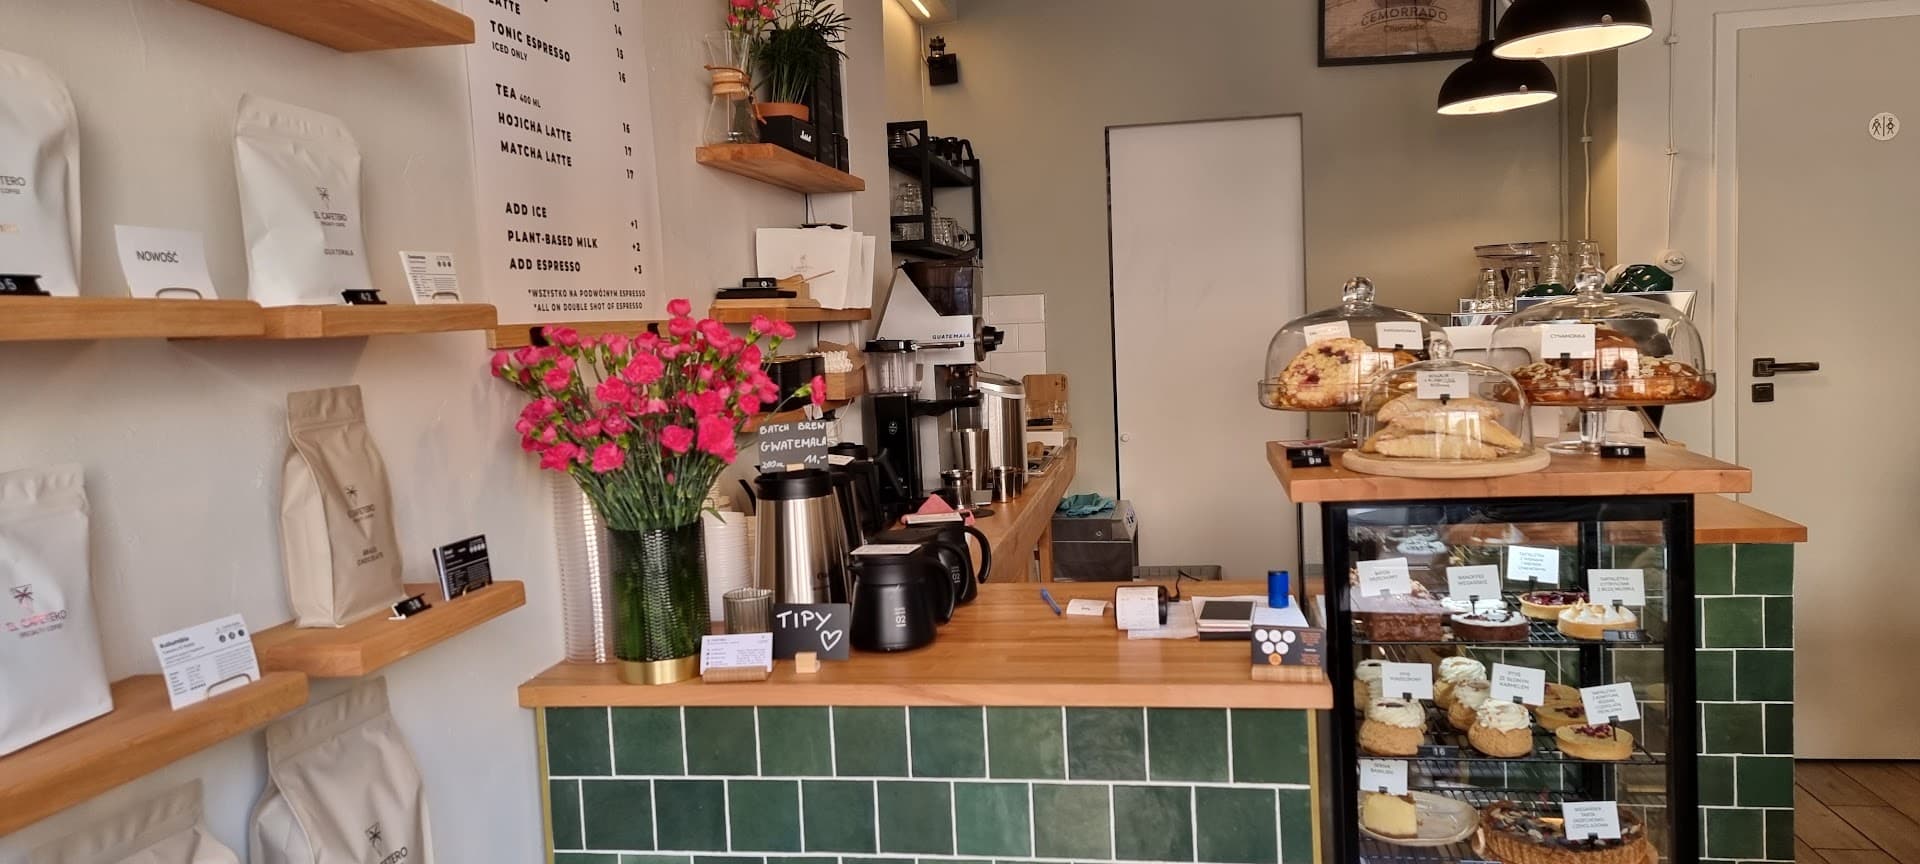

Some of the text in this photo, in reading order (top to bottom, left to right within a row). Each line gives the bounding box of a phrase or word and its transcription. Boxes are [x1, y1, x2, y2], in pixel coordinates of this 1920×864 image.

[489, 0, 521, 15] ATTE
[615, 24, 622, 36] 14
[490, 20, 571, 62] TONIC ESPRESSO
[492, 41, 528, 61] ICED ONLY
[617, 48, 624, 60] 15
[619, 72, 626, 83] 16
[496, 83, 541, 108] TEA 400 ML
[498, 112, 572, 142] HOJICHA LATTE
[623, 123, 630, 134] 16
[500, 140, 572, 167] MATCHA LATTE
[624, 146, 632, 157] 17
[626, 169, 634, 179] 17
[505, 202, 547, 218] ADD ICE
[630, 219, 638, 229] +1
[507, 230, 598, 248] PLANT-BASED MILK
[632, 242, 640, 252] +2
[509, 258, 581, 272] ADD ESPRESSO
[634, 265, 642, 274] +3
[569, 289, 577, 297] NA
[580, 287, 618, 297] PODWÓJNYM
[620, 289, 646, 297] ESPRESSO
[551, 303, 561, 311] ON
[563, 303, 588, 311] DOUBLE
[589, 302, 605, 311] SHOT
[607, 302, 614, 310] OF
[616, 302, 643, 310] ESPRESSO
[760, 421, 825, 435] BATCH BREW
[760, 436, 827, 452] GWATEMALA
[1616, 447, 1630, 456] 16
[776, 609, 832, 631] TIPY
[895, 615, 907, 624] 02
[1434, 747, 1446, 756] 16
